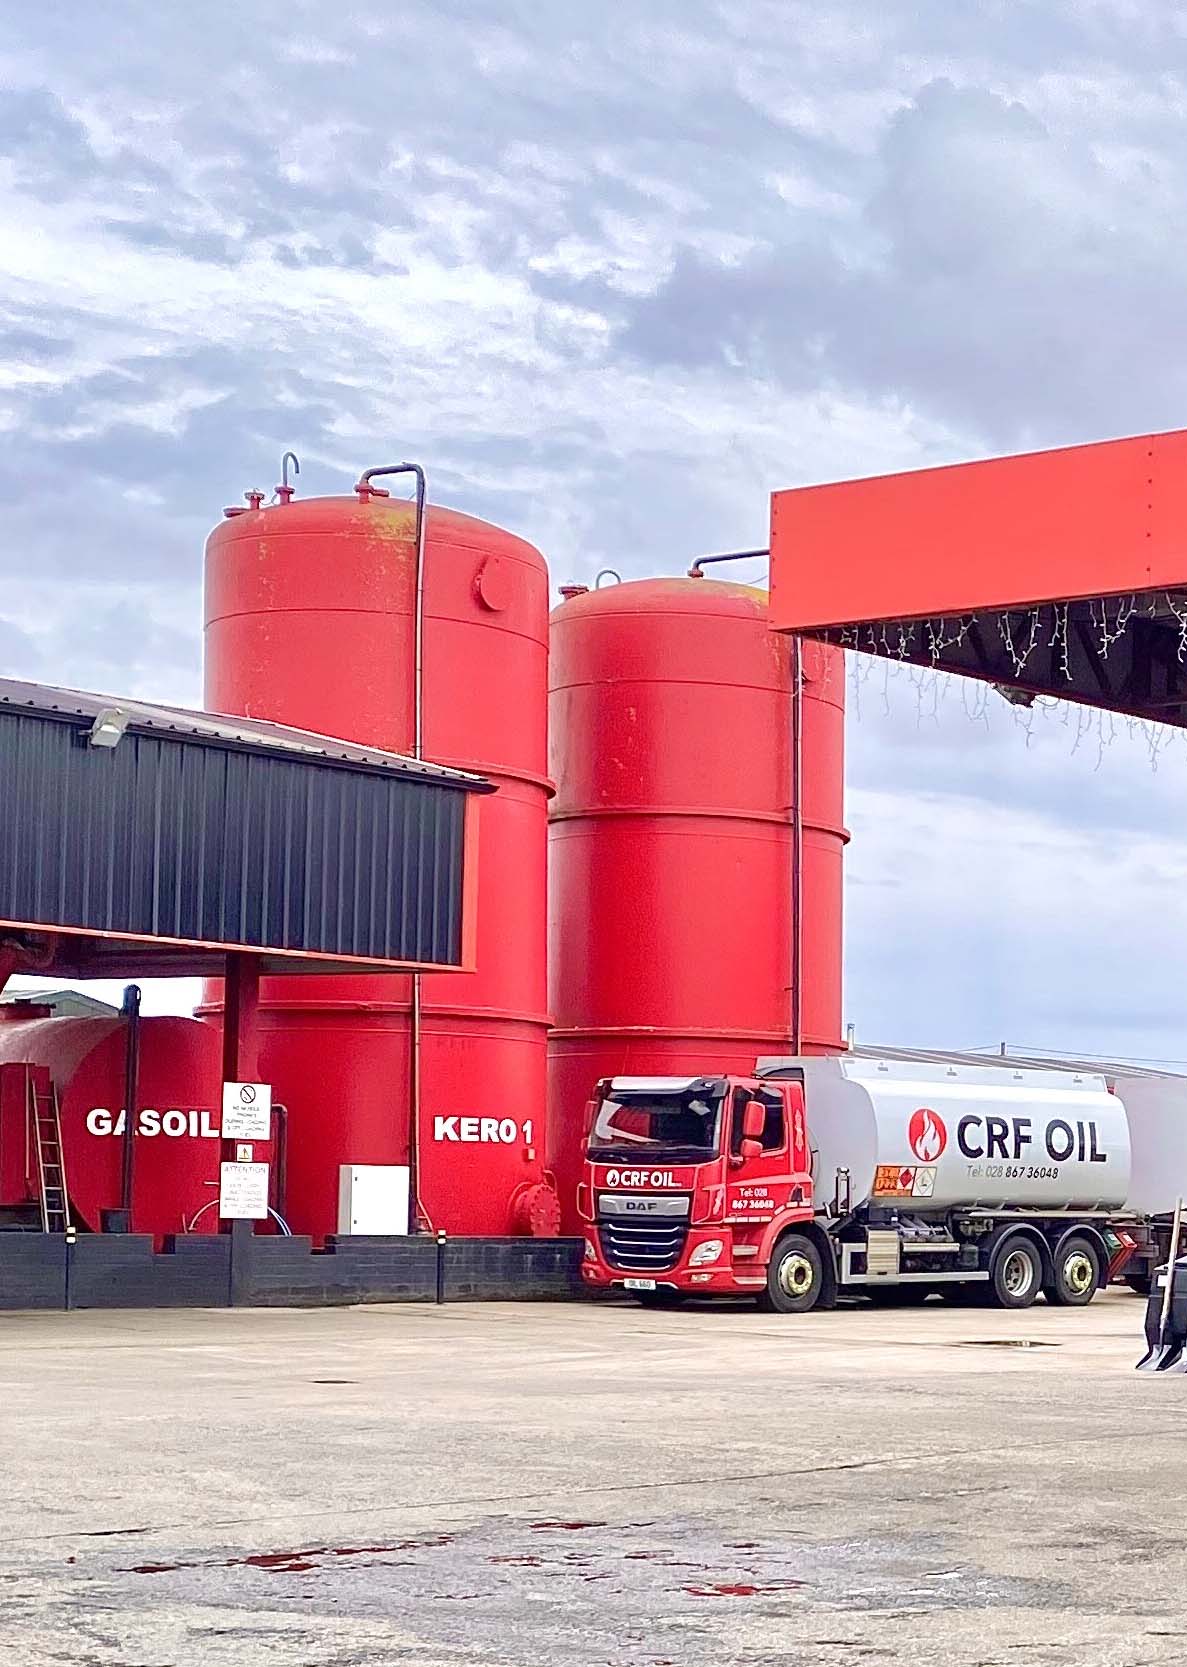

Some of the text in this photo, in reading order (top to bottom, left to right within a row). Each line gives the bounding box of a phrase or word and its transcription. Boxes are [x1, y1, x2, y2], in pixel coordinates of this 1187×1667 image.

[434, 1116, 532, 1144] KERO 1
[957, 1114, 1107, 1162] CRF OIL
[966, 1164, 1059, 1180] Tel: 028 867 36048
[626, 1202, 657, 1211] DAF
